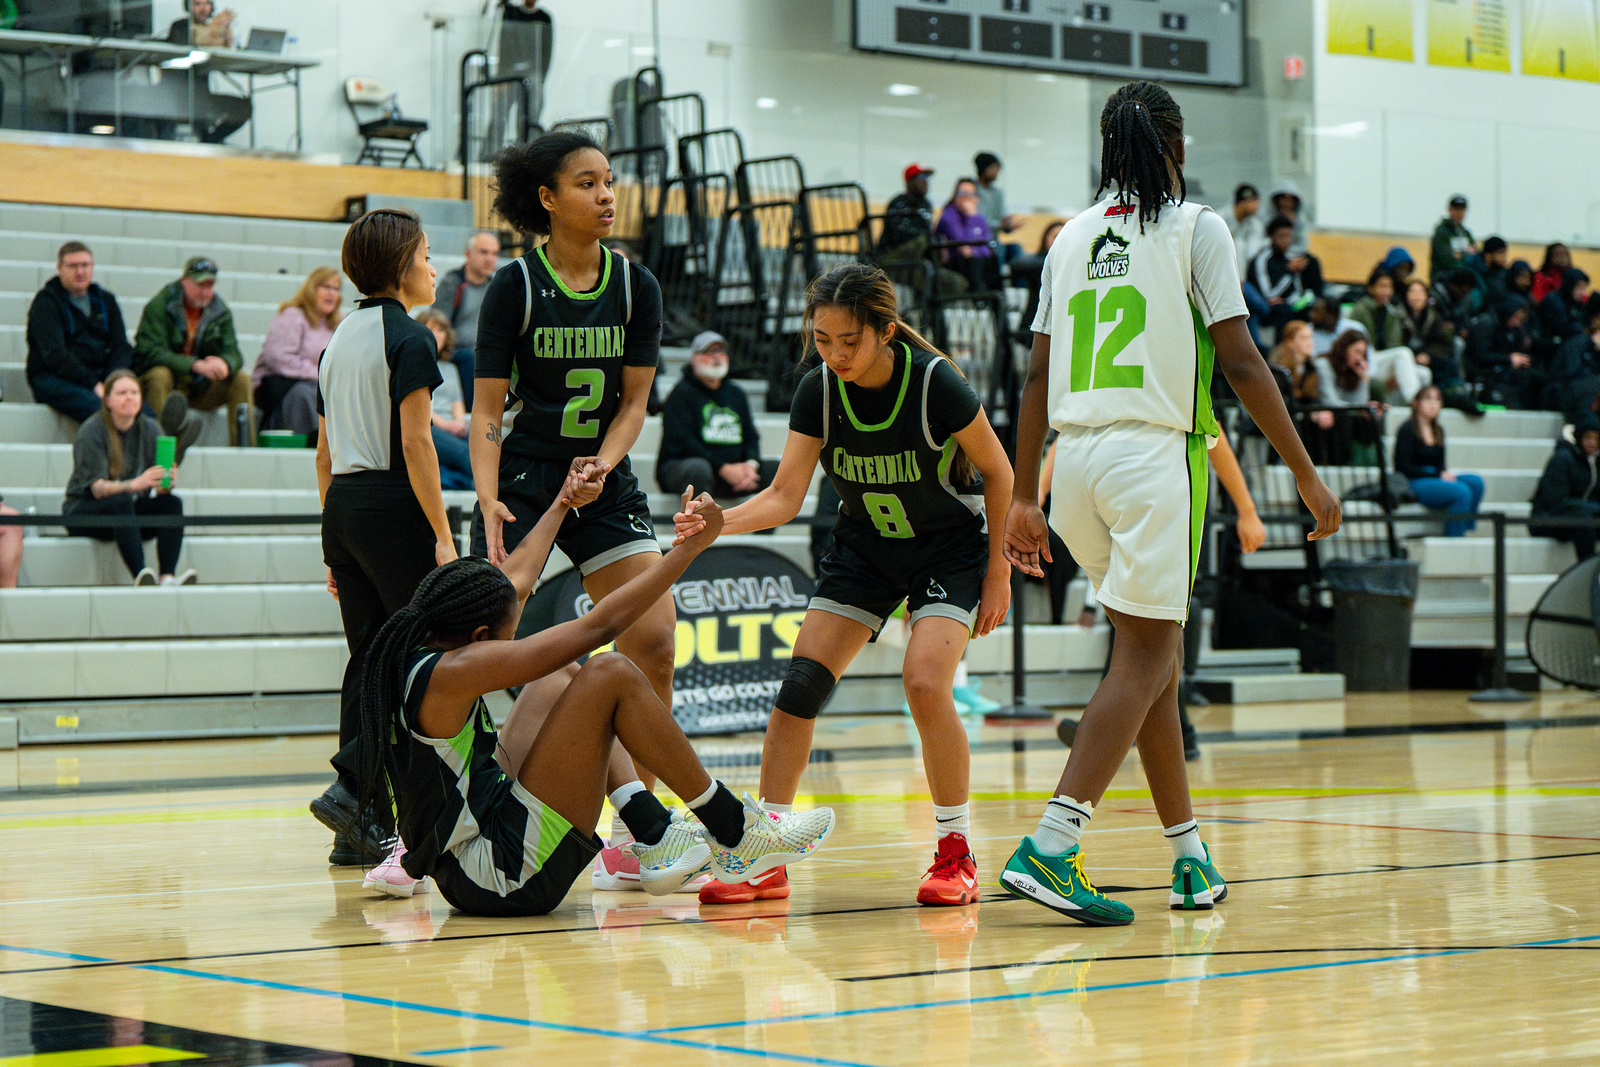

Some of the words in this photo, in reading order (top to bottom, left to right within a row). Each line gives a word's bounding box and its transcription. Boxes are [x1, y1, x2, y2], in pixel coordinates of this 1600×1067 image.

[1088, 259, 1128, 279] WOLVES
[1067, 285, 1147, 393] 12
[560, 368, 606, 439] 2
[862, 491, 916, 539] 8
[574, 575, 809, 620] CENNIAL
[673, 687, 709, 707] ETS
[708, 684, 736, 702] GO
